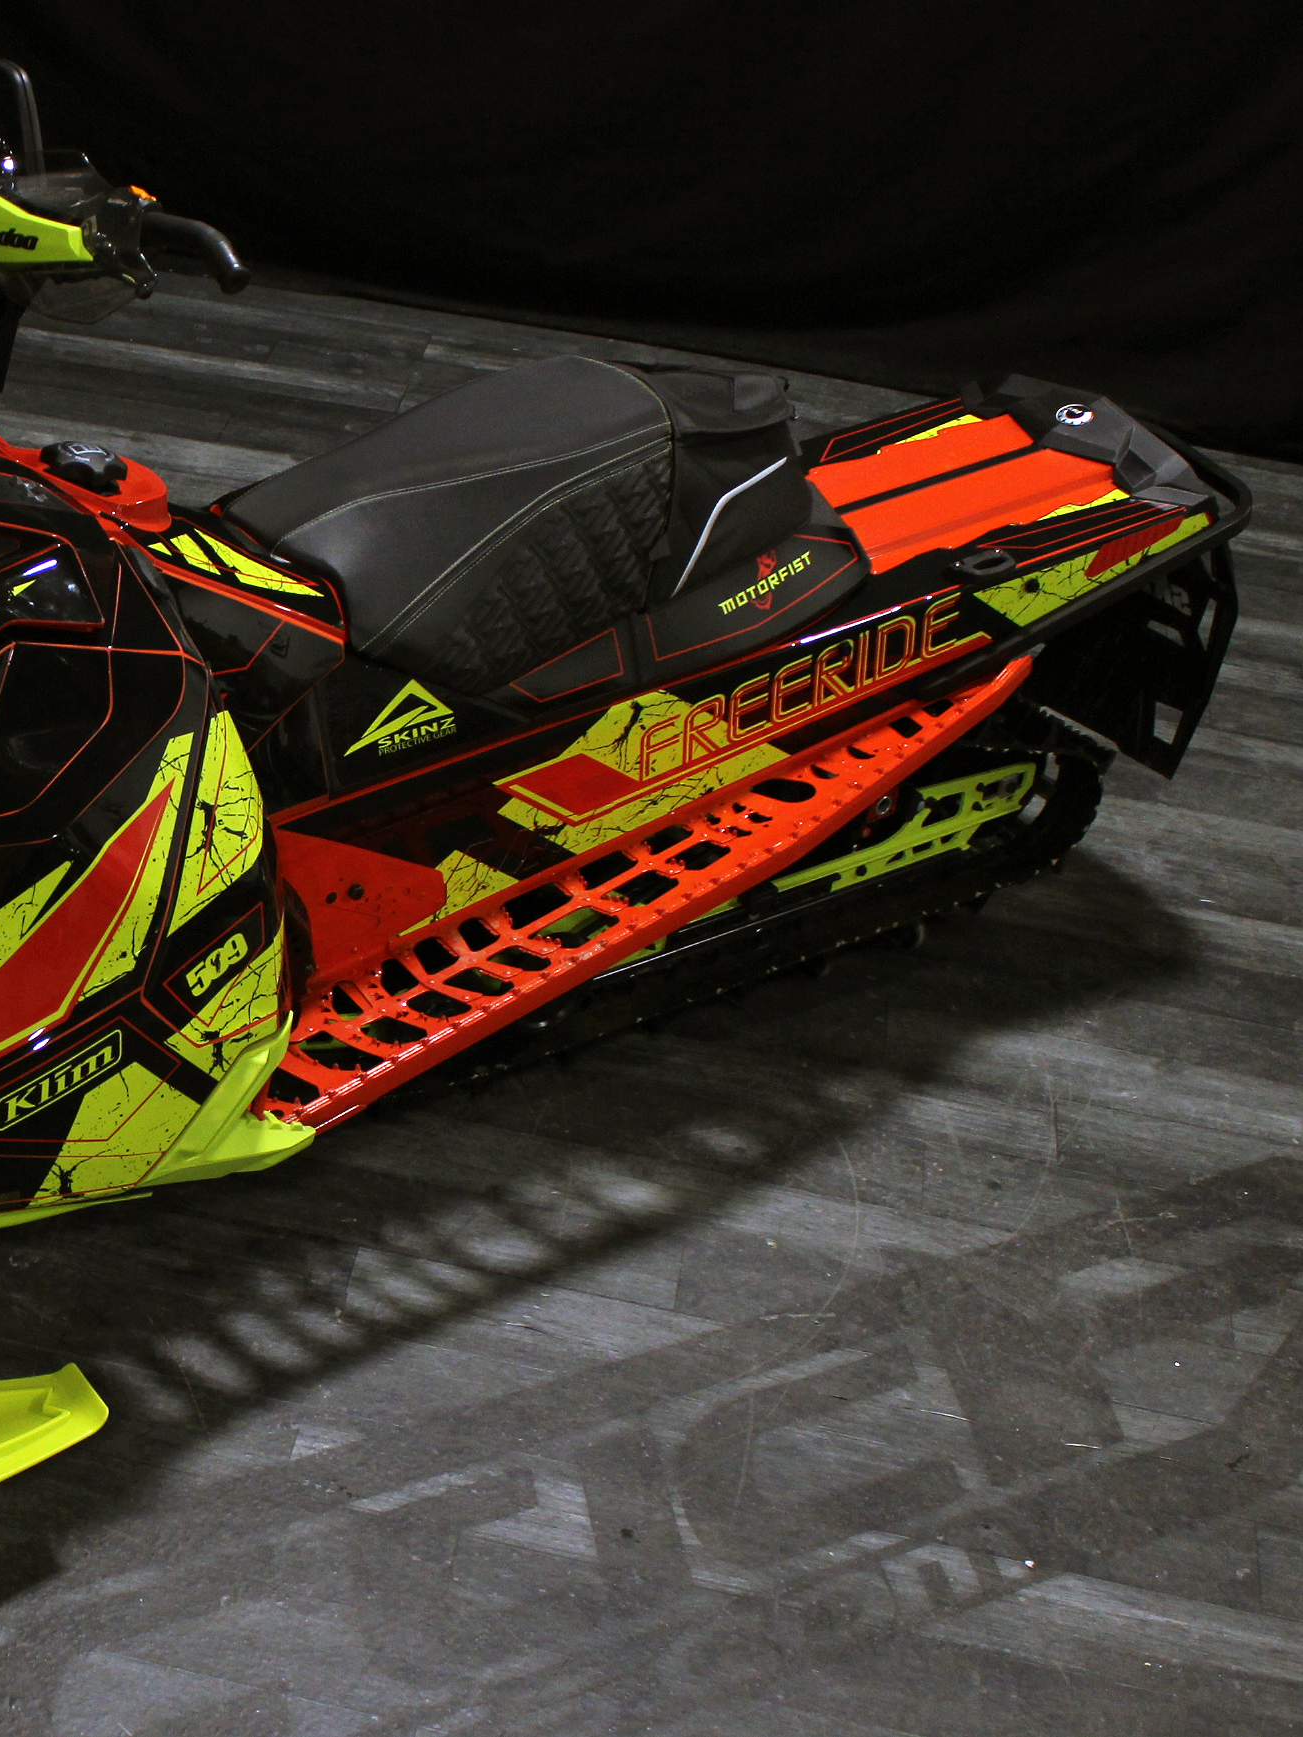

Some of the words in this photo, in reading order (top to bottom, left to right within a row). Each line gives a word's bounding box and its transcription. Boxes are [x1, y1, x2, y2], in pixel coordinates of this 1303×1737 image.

[718, 551, 812, 615] MOTORFIST
[639, 592, 962, 782] FREERIDE
[378, 716, 456, 749] SKINZ
[378, 734, 432, 756] PROTECTIVE
[433, 726, 457, 740] GEAR
[186, 932, 249, 997] 509
